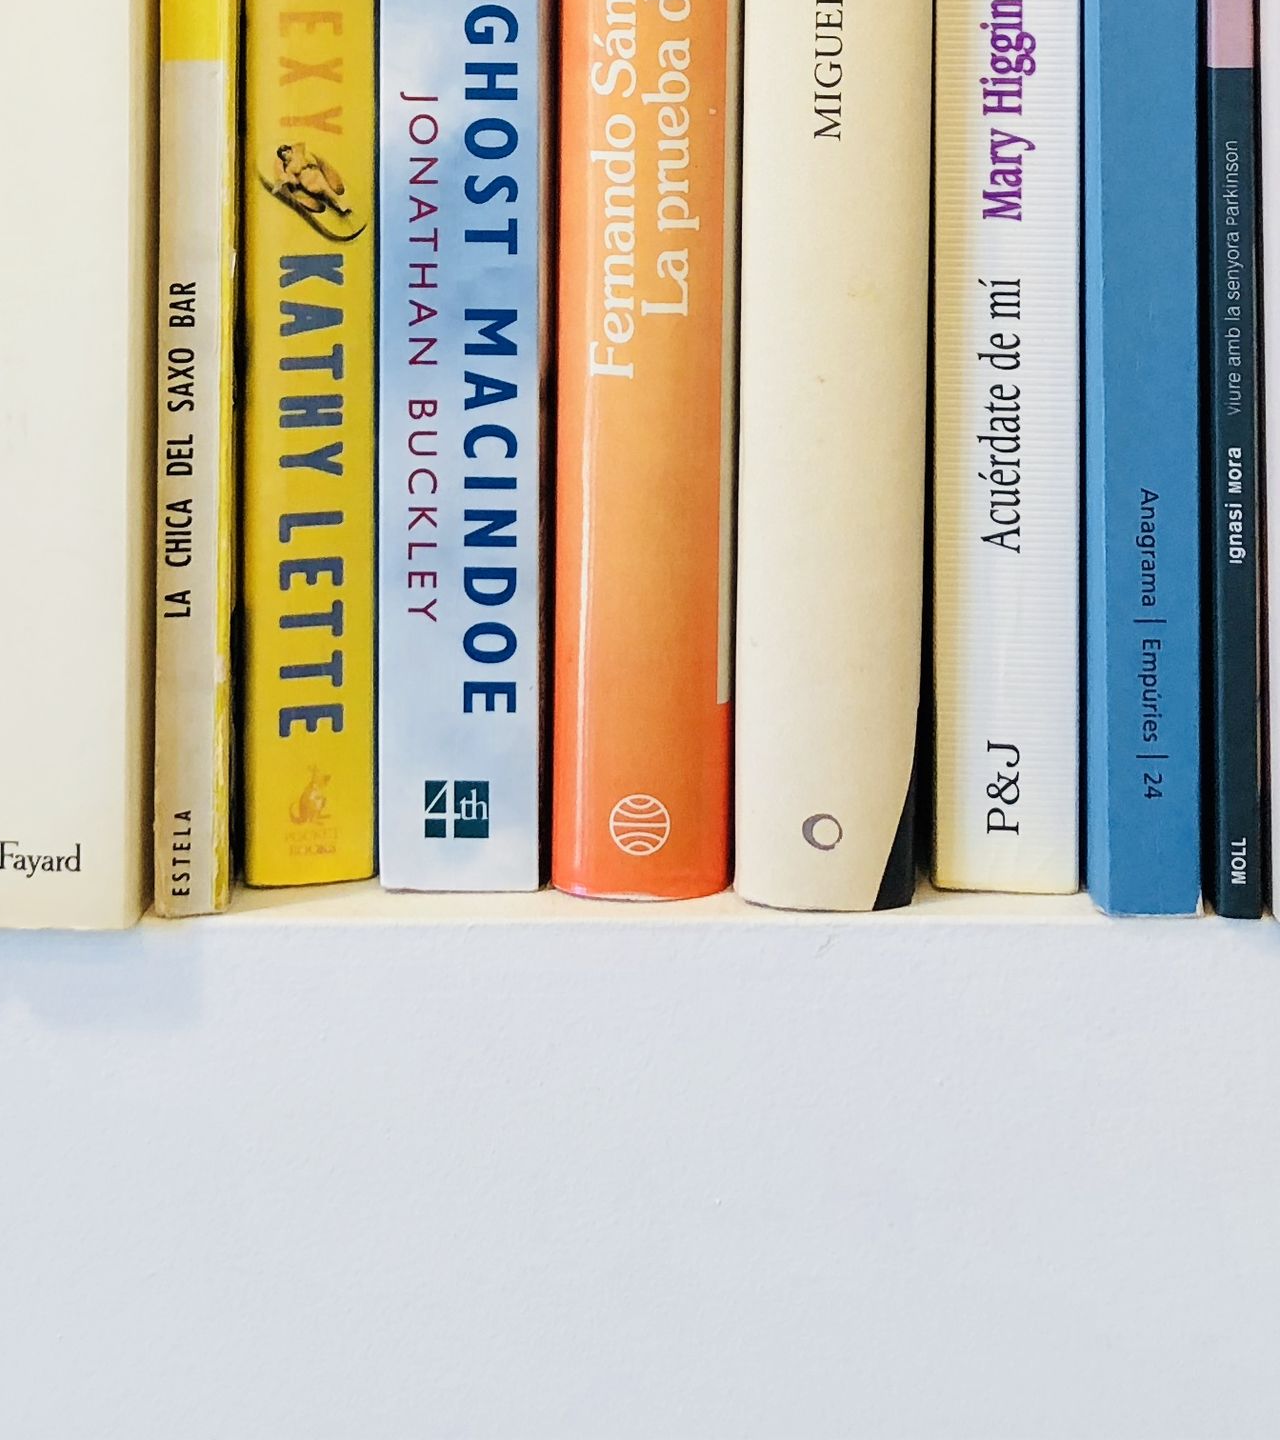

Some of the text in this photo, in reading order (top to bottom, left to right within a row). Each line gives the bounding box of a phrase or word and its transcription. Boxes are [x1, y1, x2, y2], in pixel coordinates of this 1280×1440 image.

[641, 38, 699, 231] prueba
[982, 126, 1036, 222] Mary
[1226, 140, 1240, 225] Parkinson
[589, 113, 636, 380] Fernando
[640, 248, 690, 317] La
[1226, 231, 1244, 301] senyora
[400, 92, 439, 622] JONATHAN BUCKLEY
[463, 4, 519, 713] GHOST MACINDOE
[1225, 310, 1242, 324] la
[1225, 327, 1241, 365] amb
[164, 283, 196, 619] LA CHICA DEL SAXO BAR
[977, 278, 1020, 554] Acuérdate de mí
[278, 255, 344, 738] KATHY LETTE
[1137, 488, 1160, 609] Anagrama
[1137, 638, 1160, 743] Empúries
[986, 741, 1019, 834] P&J
[1143, 771, 1162, 799] 24
[171, 810, 191, 896] ESTELA
[1230, 837, 1247, 885] MOLL
